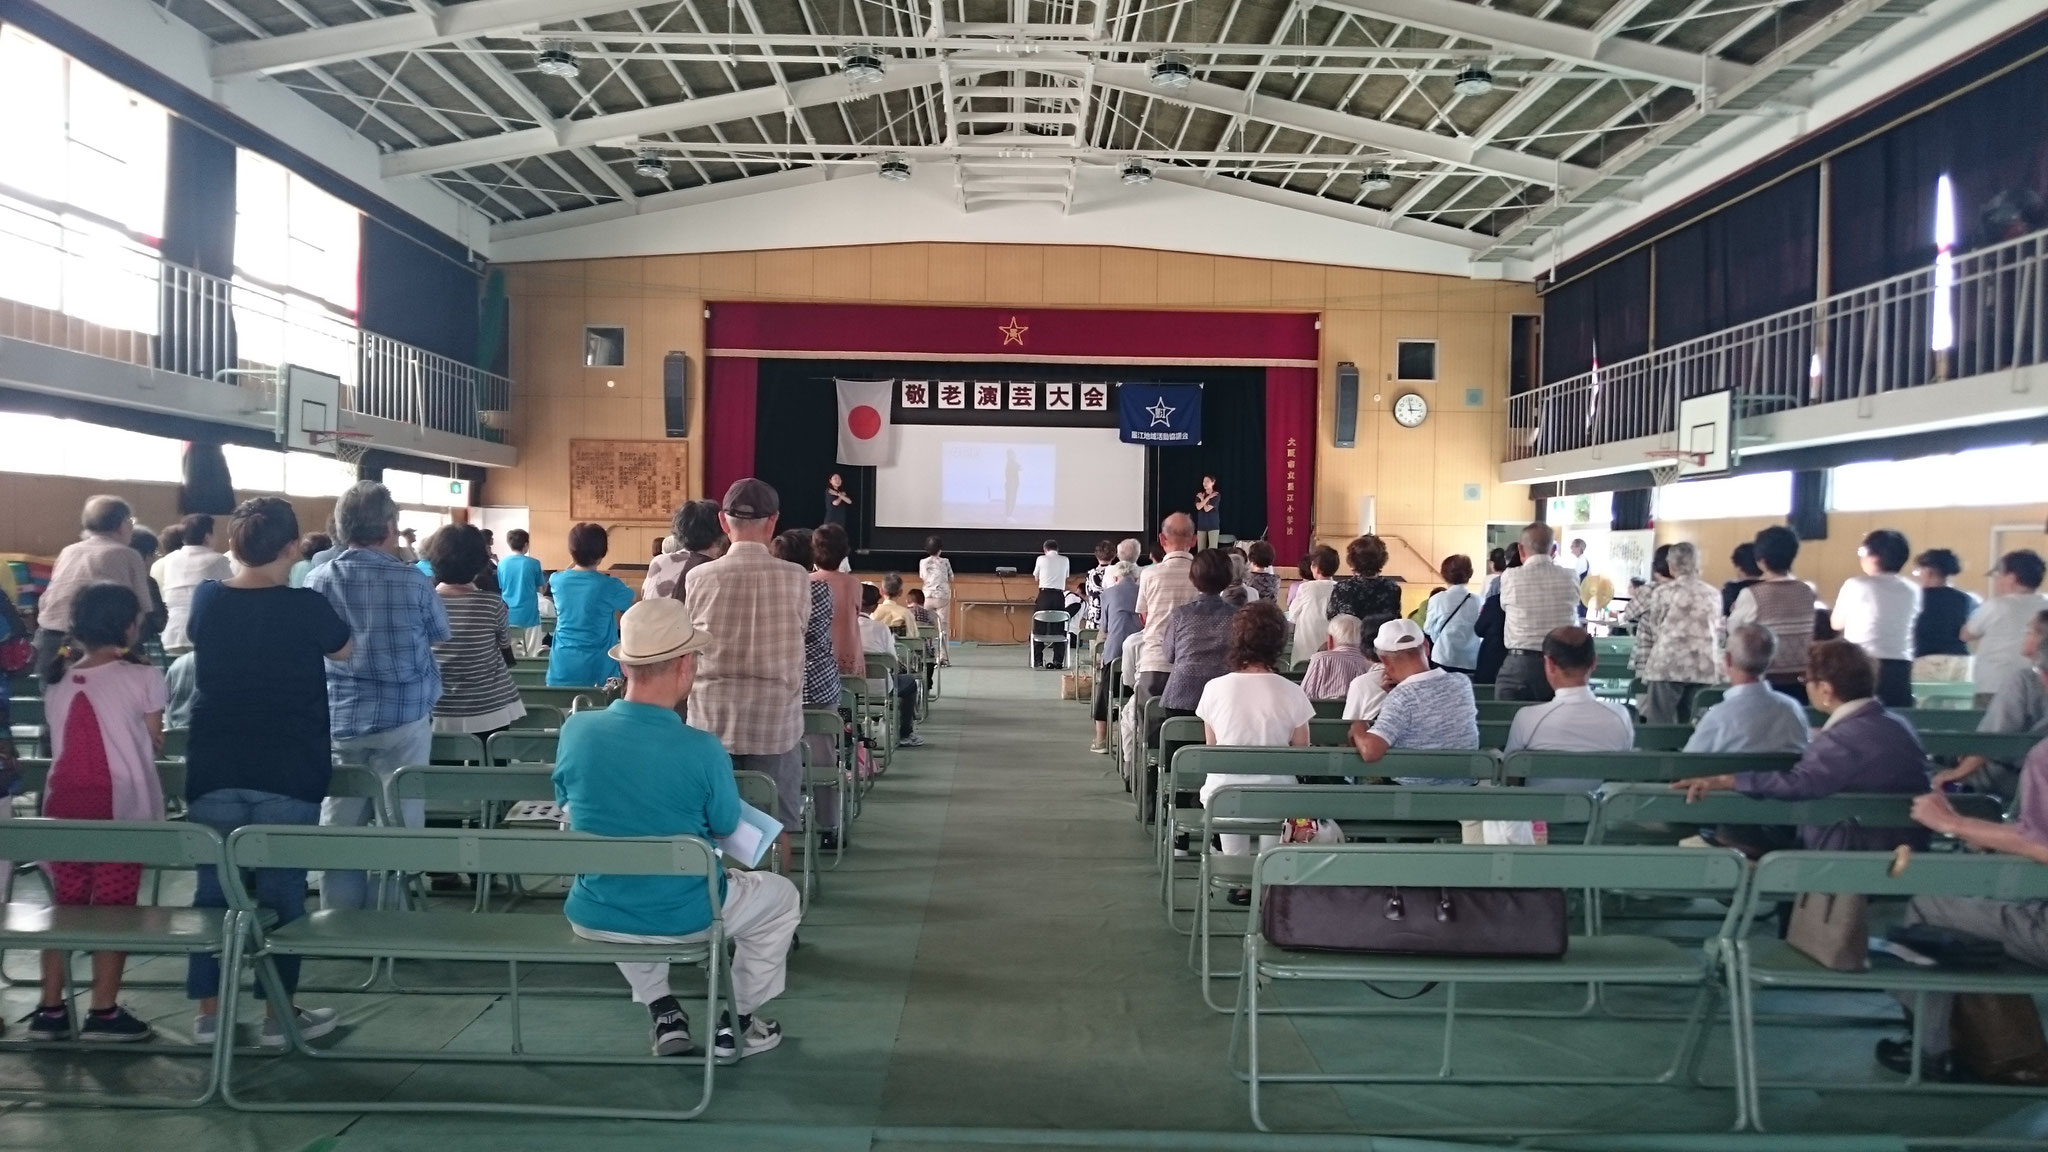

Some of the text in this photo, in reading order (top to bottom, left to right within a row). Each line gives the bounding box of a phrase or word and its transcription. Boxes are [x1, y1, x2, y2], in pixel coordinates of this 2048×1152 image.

[905, 384, 1105, 408] 敬老演芸大会
